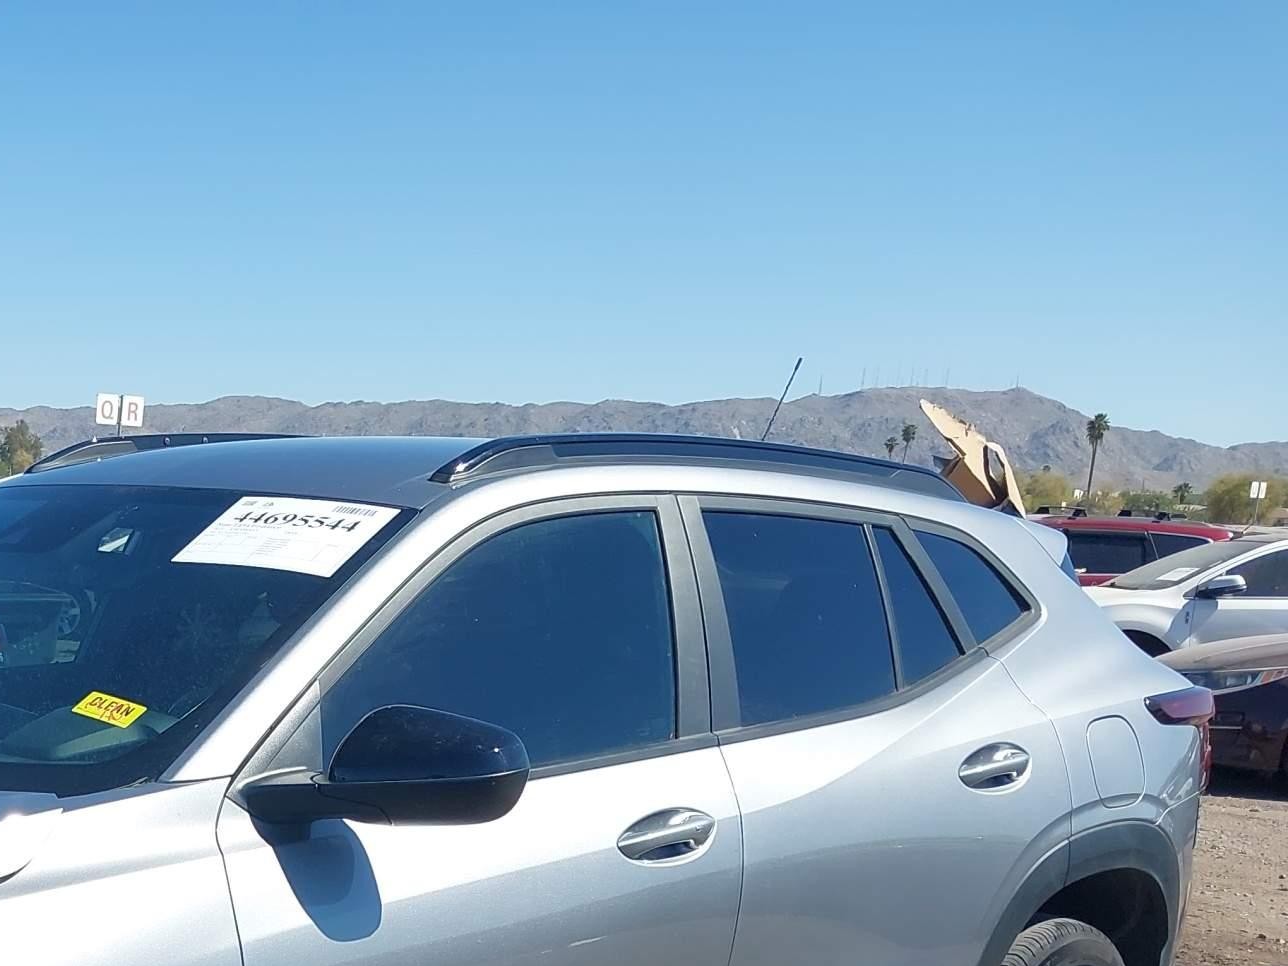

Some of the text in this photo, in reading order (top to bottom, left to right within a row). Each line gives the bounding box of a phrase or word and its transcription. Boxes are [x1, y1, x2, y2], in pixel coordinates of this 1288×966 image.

[102, 400, 138, 421] Q R
[234, 511, 362, 533] 44695544
[88, 696, 136, 717] CLEAN
